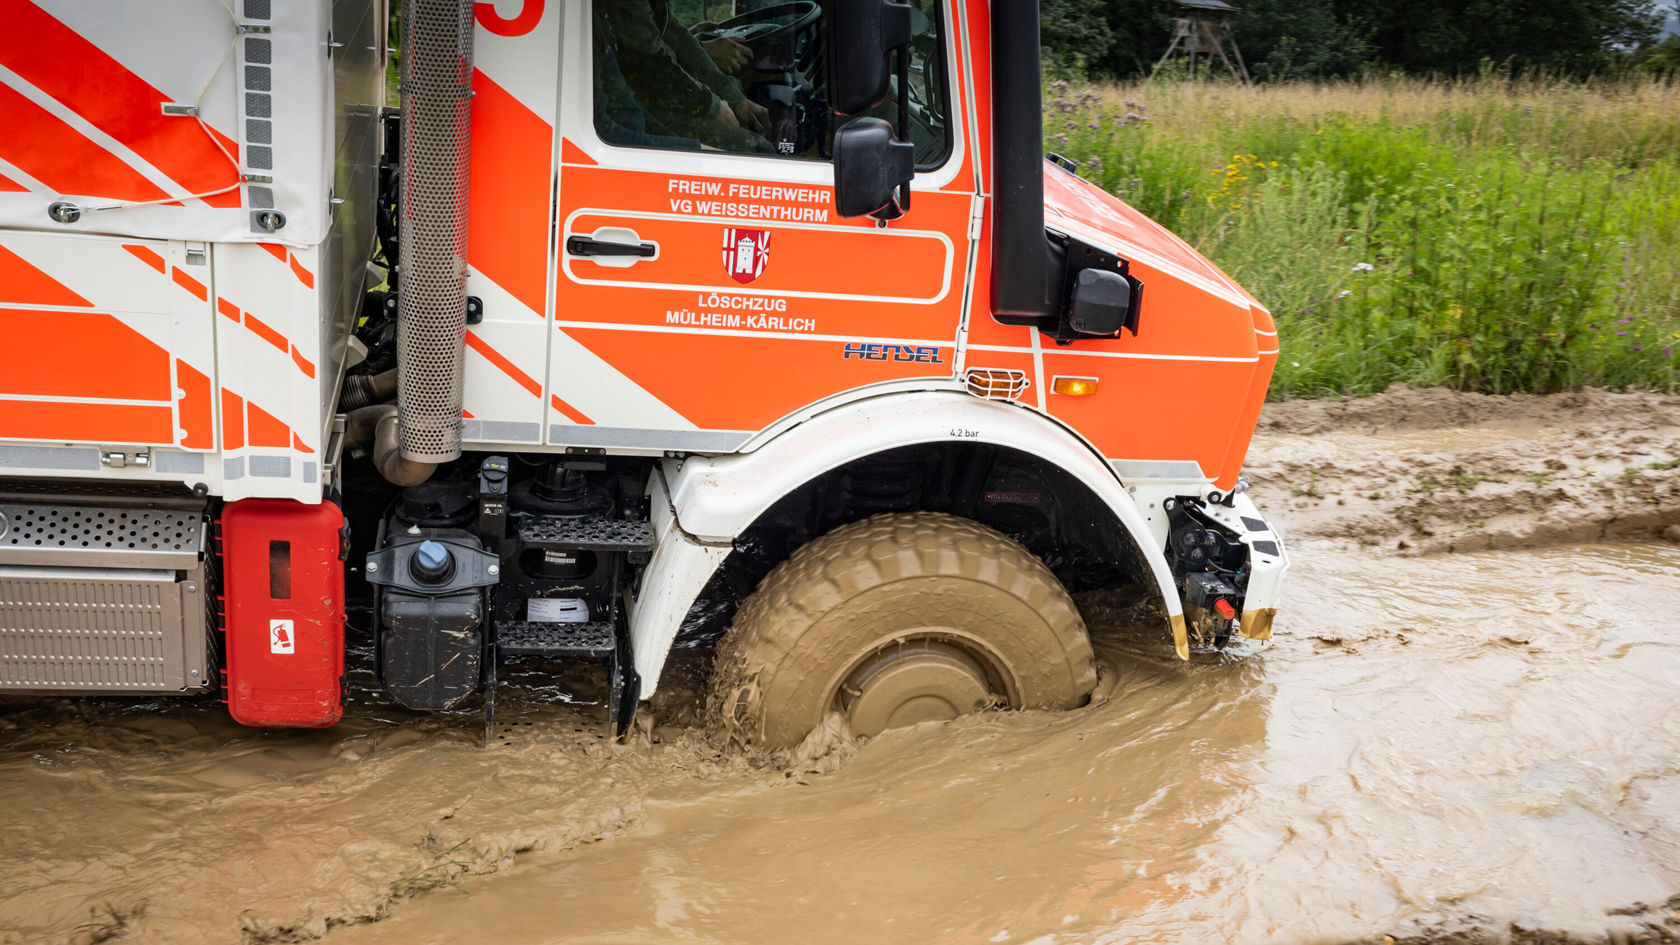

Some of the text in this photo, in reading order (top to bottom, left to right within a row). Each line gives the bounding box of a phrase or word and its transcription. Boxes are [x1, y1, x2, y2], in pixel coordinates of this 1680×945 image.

[668, 179, 831, 203] FREIW. FEUERWEHR
[670, 198, 828, 222] VG WEISSENTHURM
[698, 293, 787, 311] LÖSCHZUG
[666, 309, 815, 331] MÜLHEIM-KÄRLICH
[844, 343, 944, 363] HENSEL
[965, 428, 979, 438] bar
